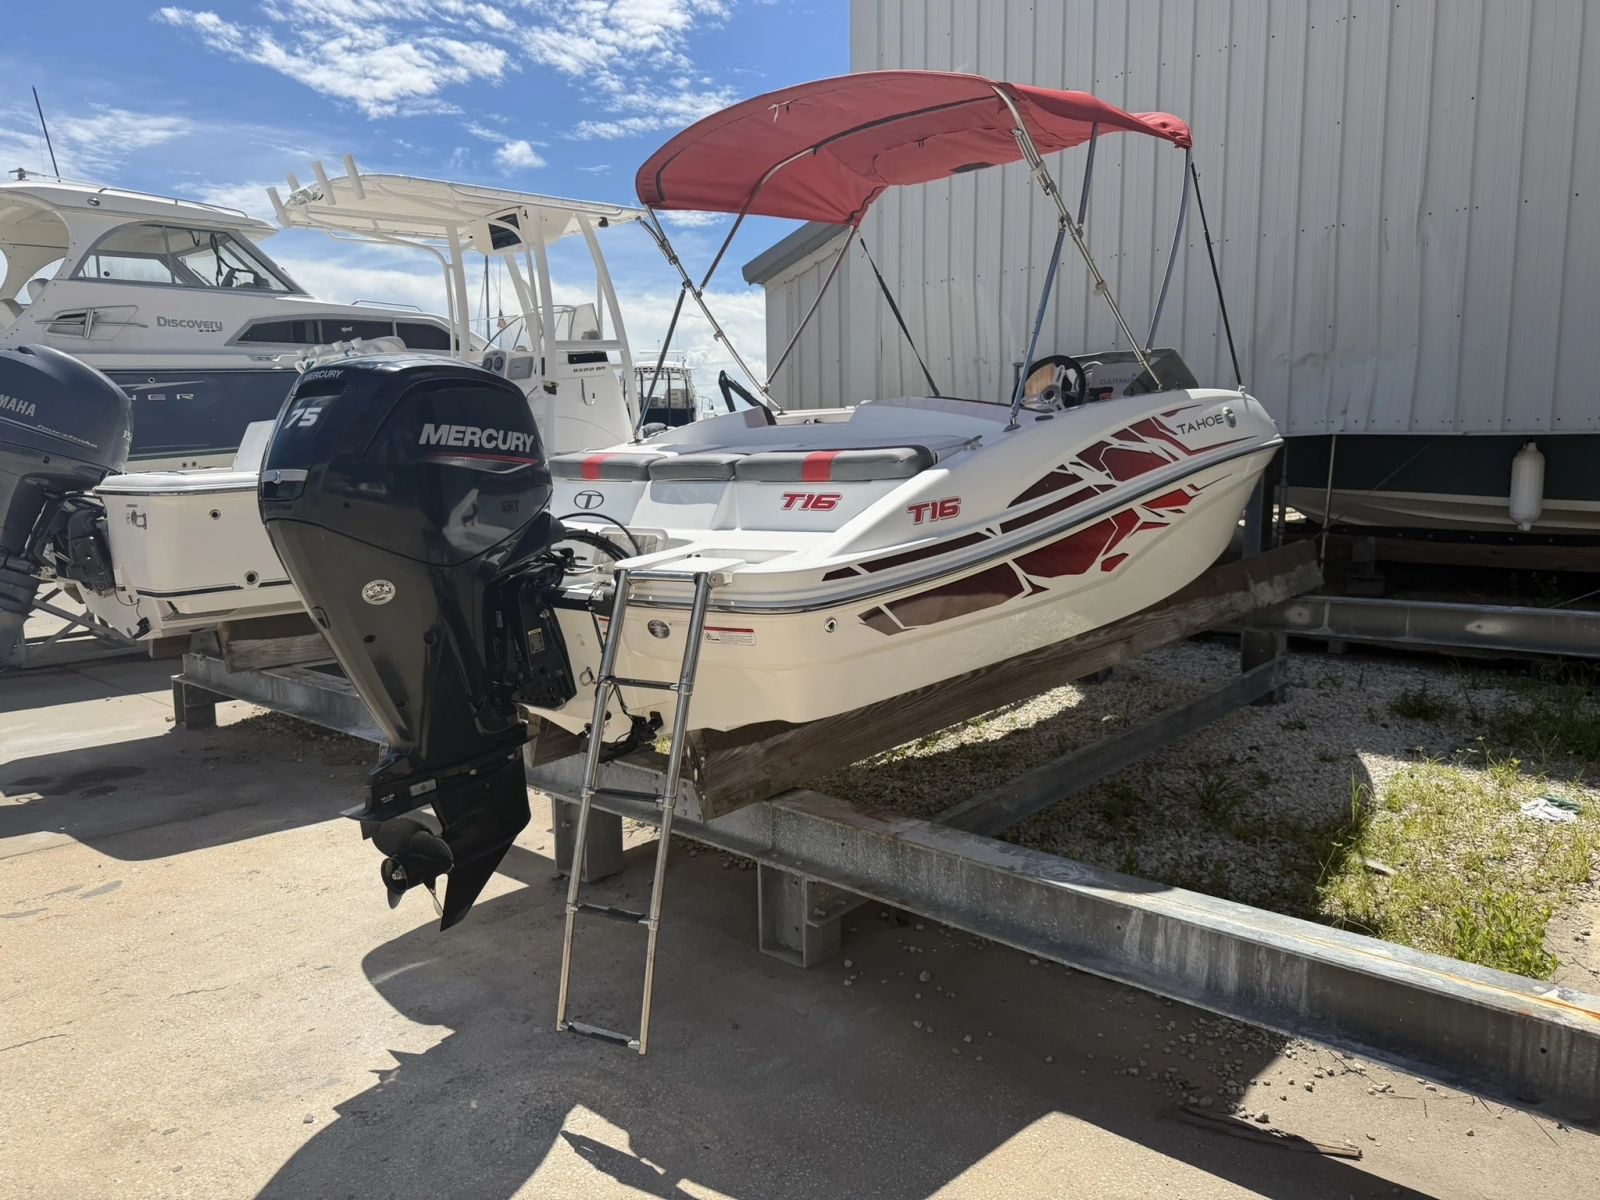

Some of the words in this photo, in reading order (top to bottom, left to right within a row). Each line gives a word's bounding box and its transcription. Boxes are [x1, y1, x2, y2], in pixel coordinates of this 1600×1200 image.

[156, 315, 223, 332] Discovery
[303, 369, 344, 381] MERCURY
[0, 394, 37, 417] MAHA
[284, 407, 323, 429] 75
[1176, 413, 1225, 435] TAHOE
[122, 429, 133, 444] 15
[418, 423, 535, 453] MERCURY
[780, 491, 843, 511] T16
[906, 495, 962, 526] T16
